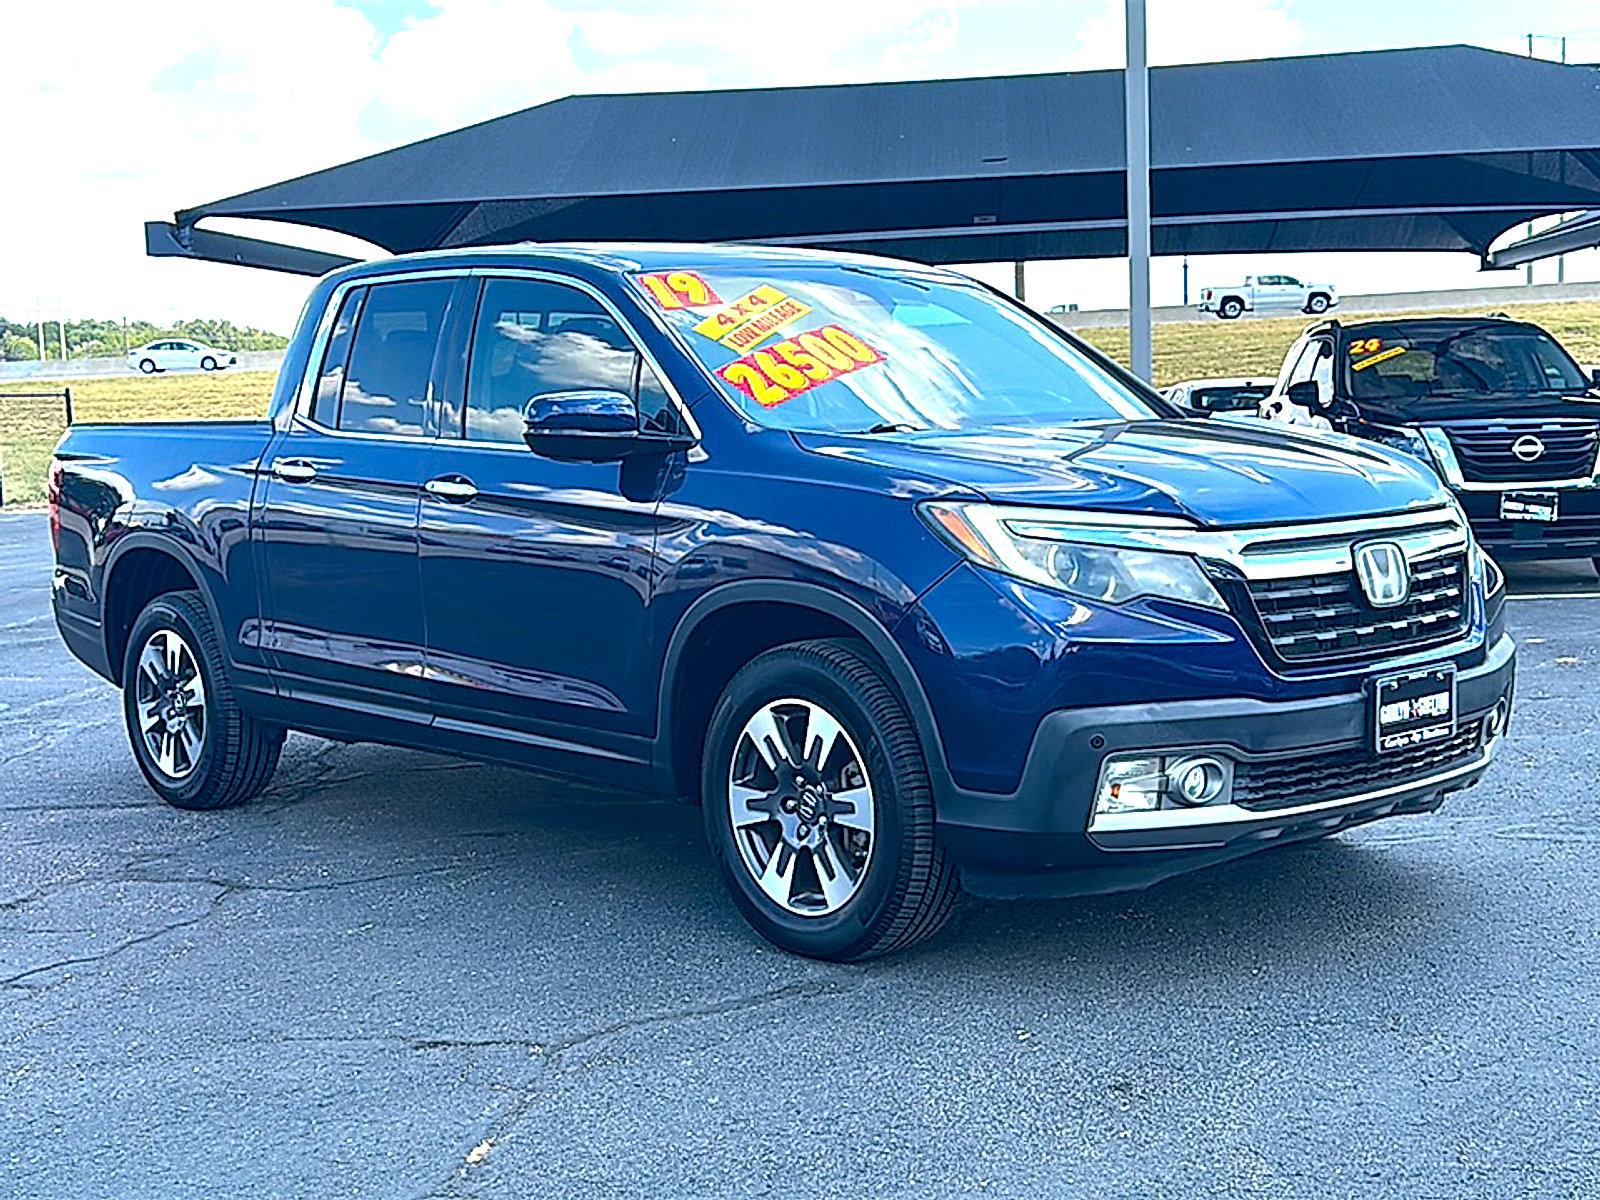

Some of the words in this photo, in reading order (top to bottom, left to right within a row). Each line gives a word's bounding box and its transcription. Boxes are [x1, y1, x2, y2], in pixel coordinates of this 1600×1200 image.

[643, 272, 709, 308] 19
[727, 327, 761, 348] LOW
[751, 301, 802, 333] MILEAGE
[722, 326, 878, 404] 26500
